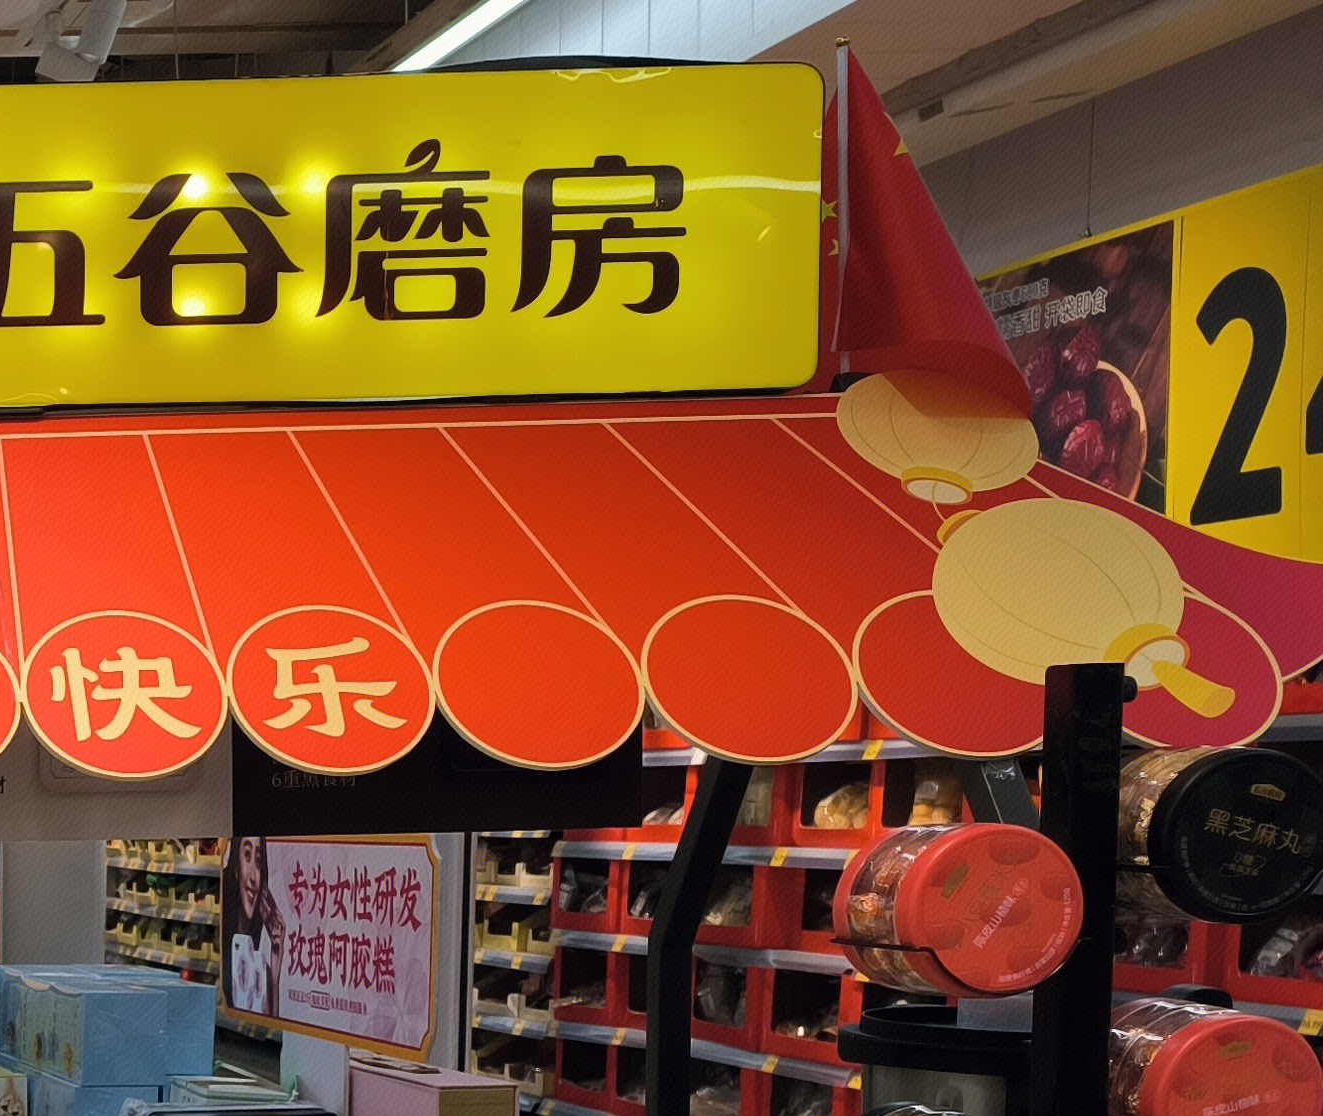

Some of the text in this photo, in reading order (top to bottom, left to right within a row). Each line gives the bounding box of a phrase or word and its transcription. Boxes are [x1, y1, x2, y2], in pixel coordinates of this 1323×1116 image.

[289, 861, 421, 931] 专为女性研发
[288, 924, 395, 994] 玫瑰阿胶糕
